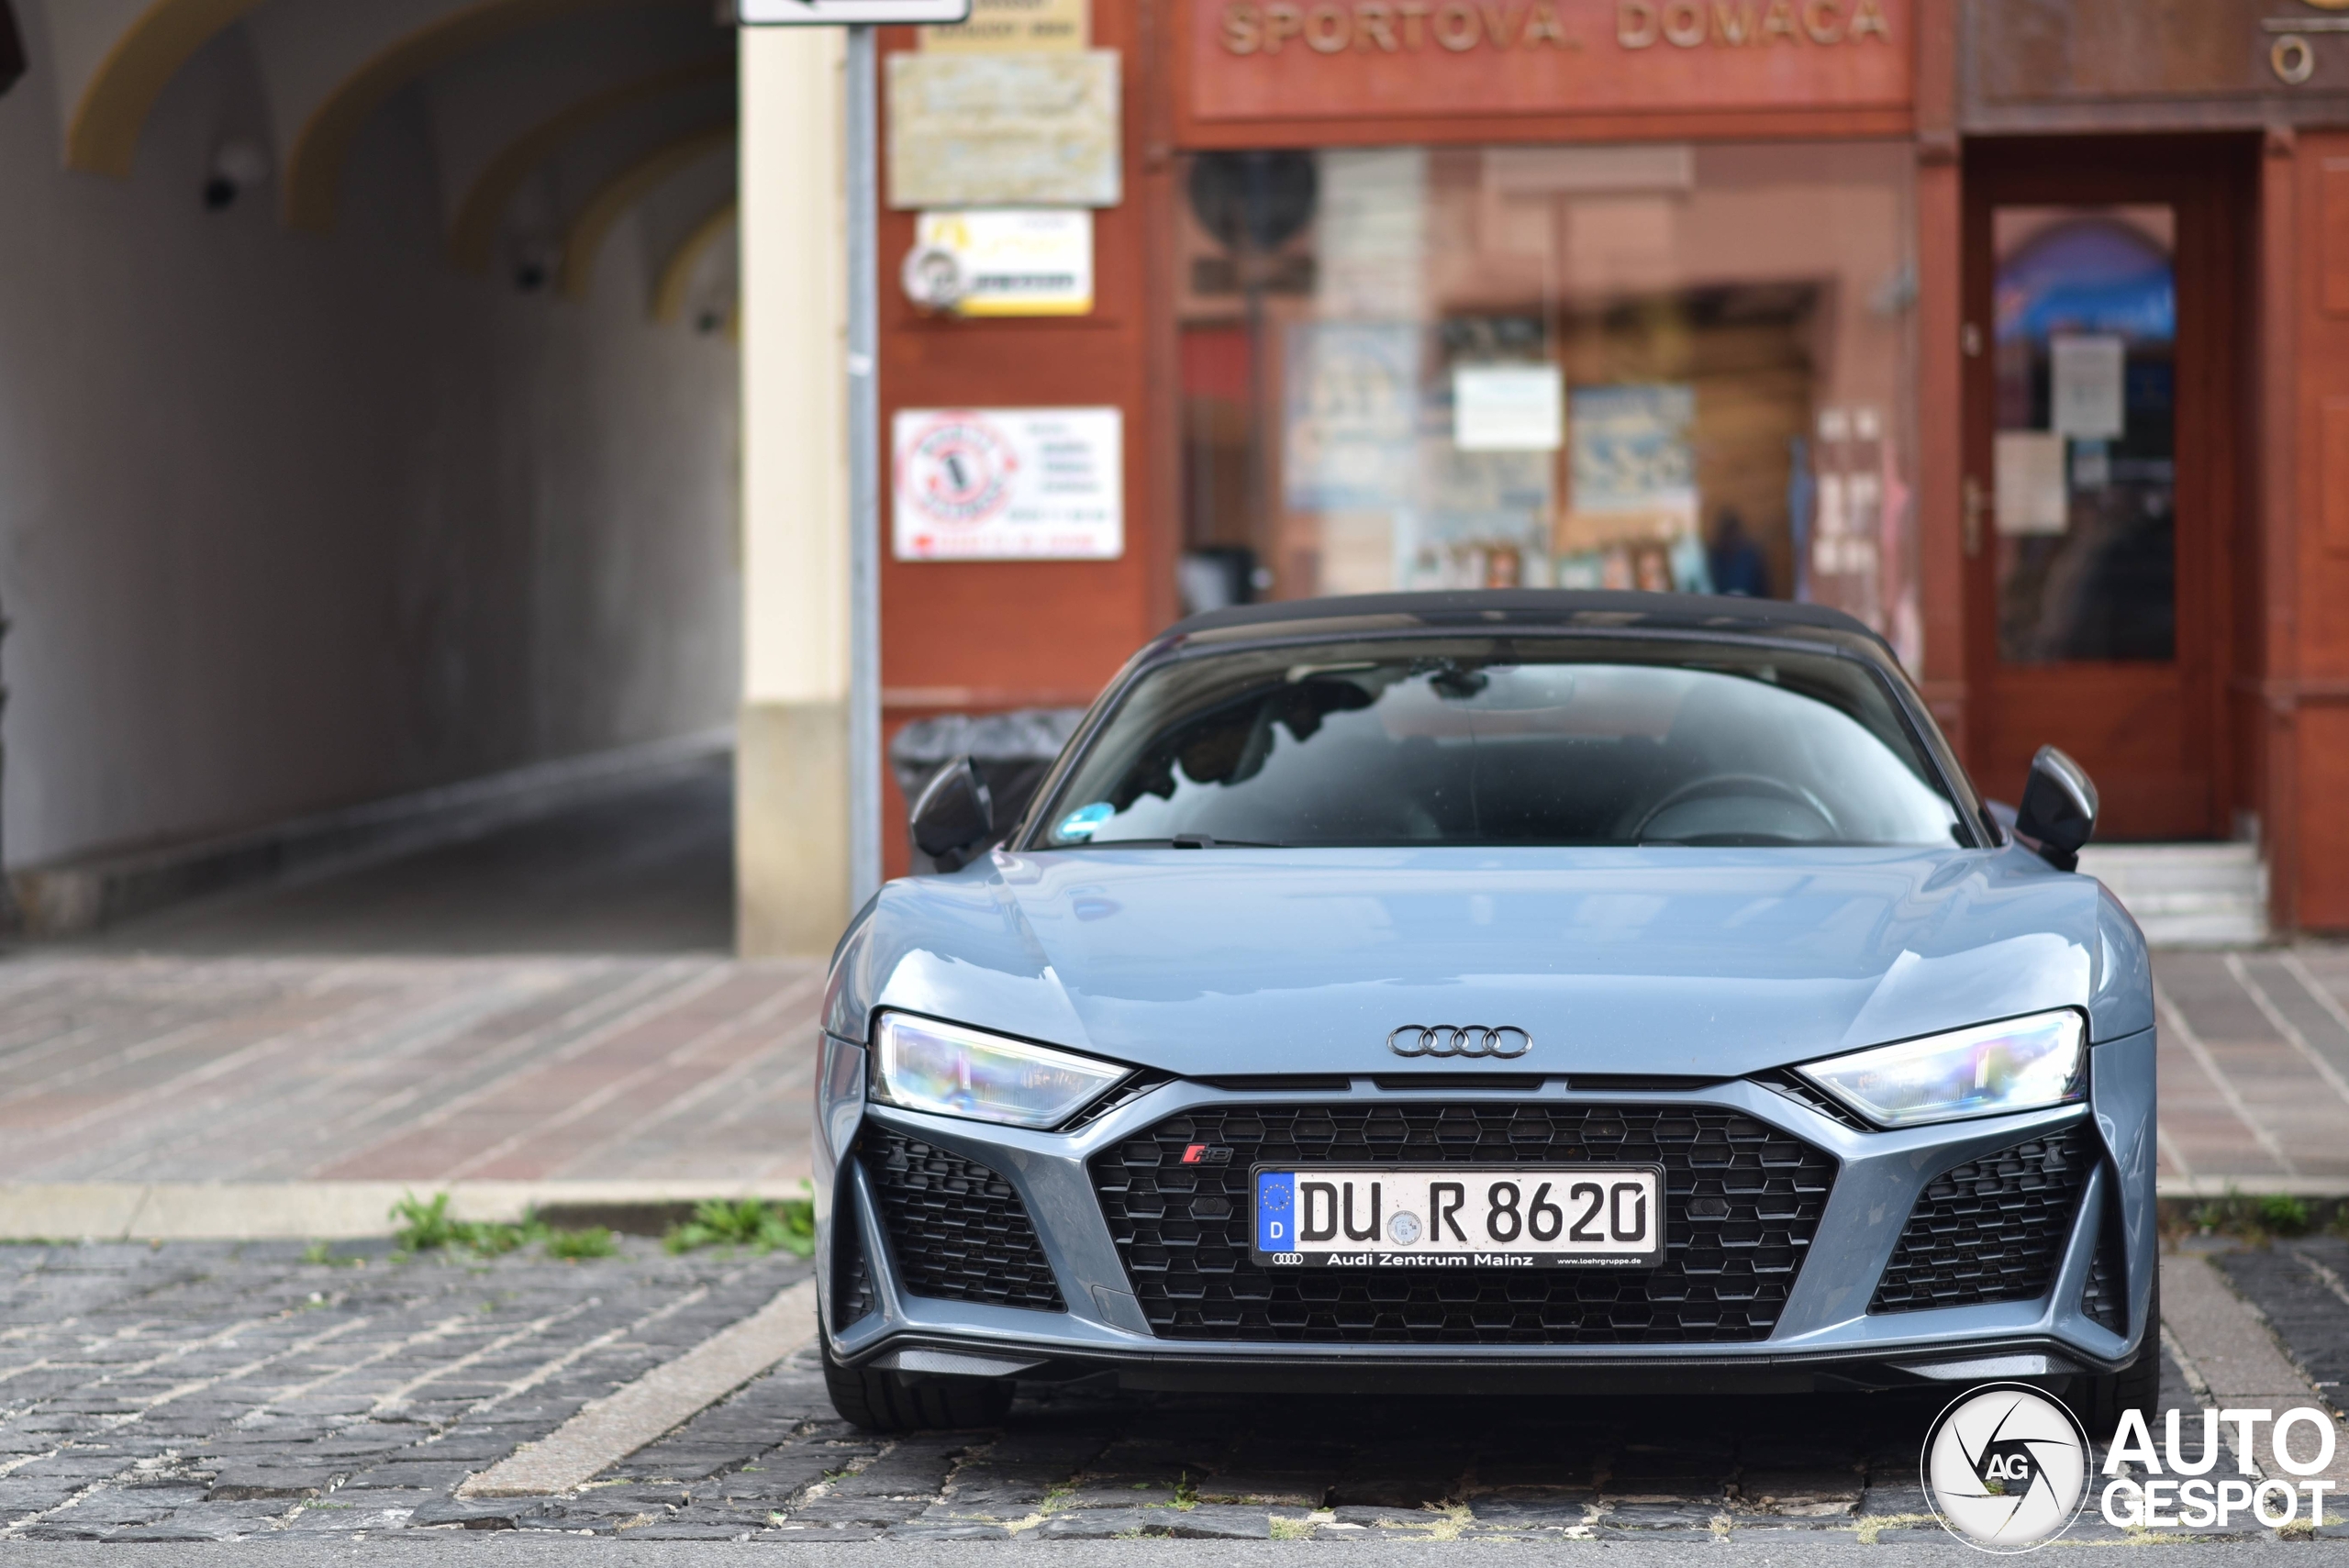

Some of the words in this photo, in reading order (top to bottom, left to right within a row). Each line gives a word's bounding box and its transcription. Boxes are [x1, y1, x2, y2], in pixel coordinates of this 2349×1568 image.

[1193, 1149, 1230, 1161] R8
[1299, 1182, 1381, 1241] DU
[1430, 1182, 1468, 1241] R
[1486, 1182, 1646, 1242] 8620
[1270, 1222, 1284, 1239] D
[1327, 1253, 1374, 1266] Audi
[1379, 1253, 1468, 1266] Zentrum
[1475, 1253, 1534, 1266] Mainz
